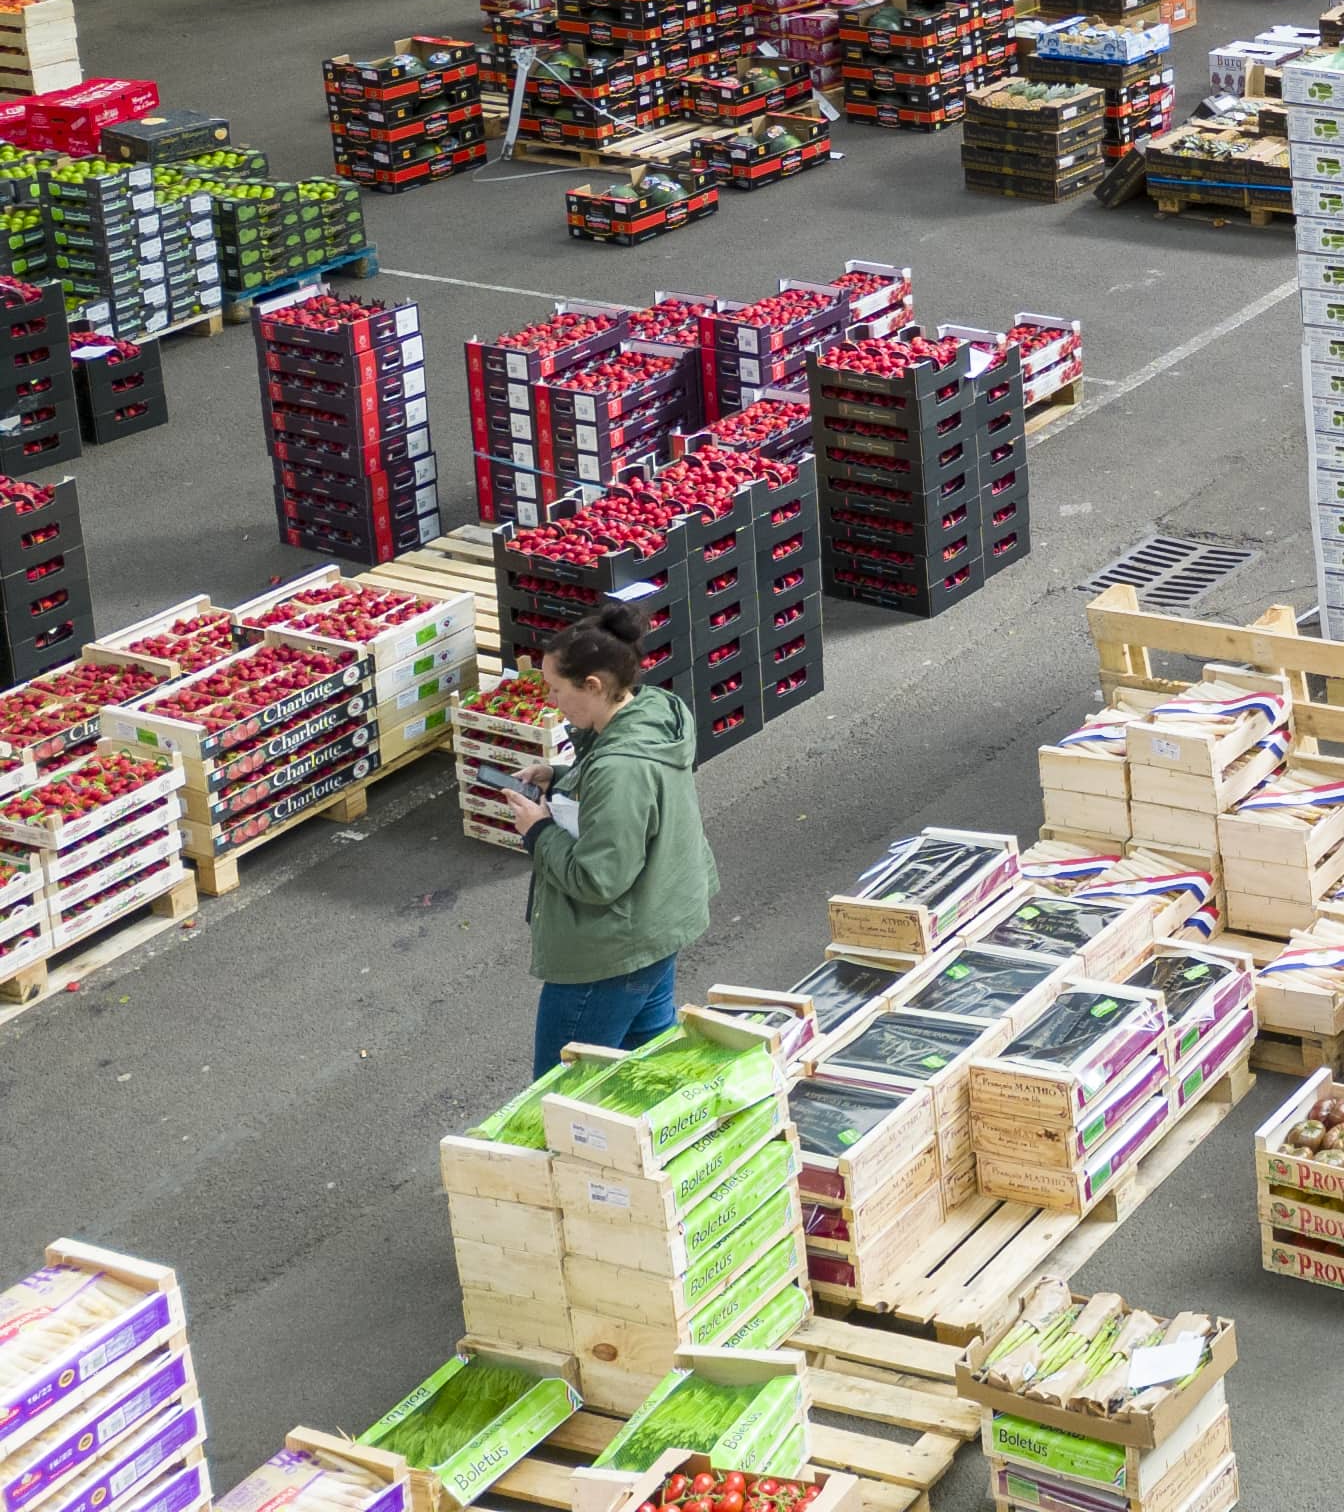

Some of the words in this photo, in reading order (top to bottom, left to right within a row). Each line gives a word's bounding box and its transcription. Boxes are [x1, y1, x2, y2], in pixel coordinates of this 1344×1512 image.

[261, 680, 335, 725] Charlotte
[267, 710, 339, 757] Charlotte
[272, 739, 343, 787] Charlotte
[274, 771, 343, 819] Charlotte
[658, 1106, 709, 1145] Boletus
[680, 1155, 724, 1199] Boletus
[711, 1167, 754, 1203] Boletus
[691, 1205, 738, 1251] Boletus
[689, 1252, 734, 1297] Boletus
[697, 1299, 740, 1341] Boletus
[722, 1409, 765, 1452] Boletus
[998, 1428, 1048, 1458] Boletus
[452, 1444, 509, 1492] Boletus
